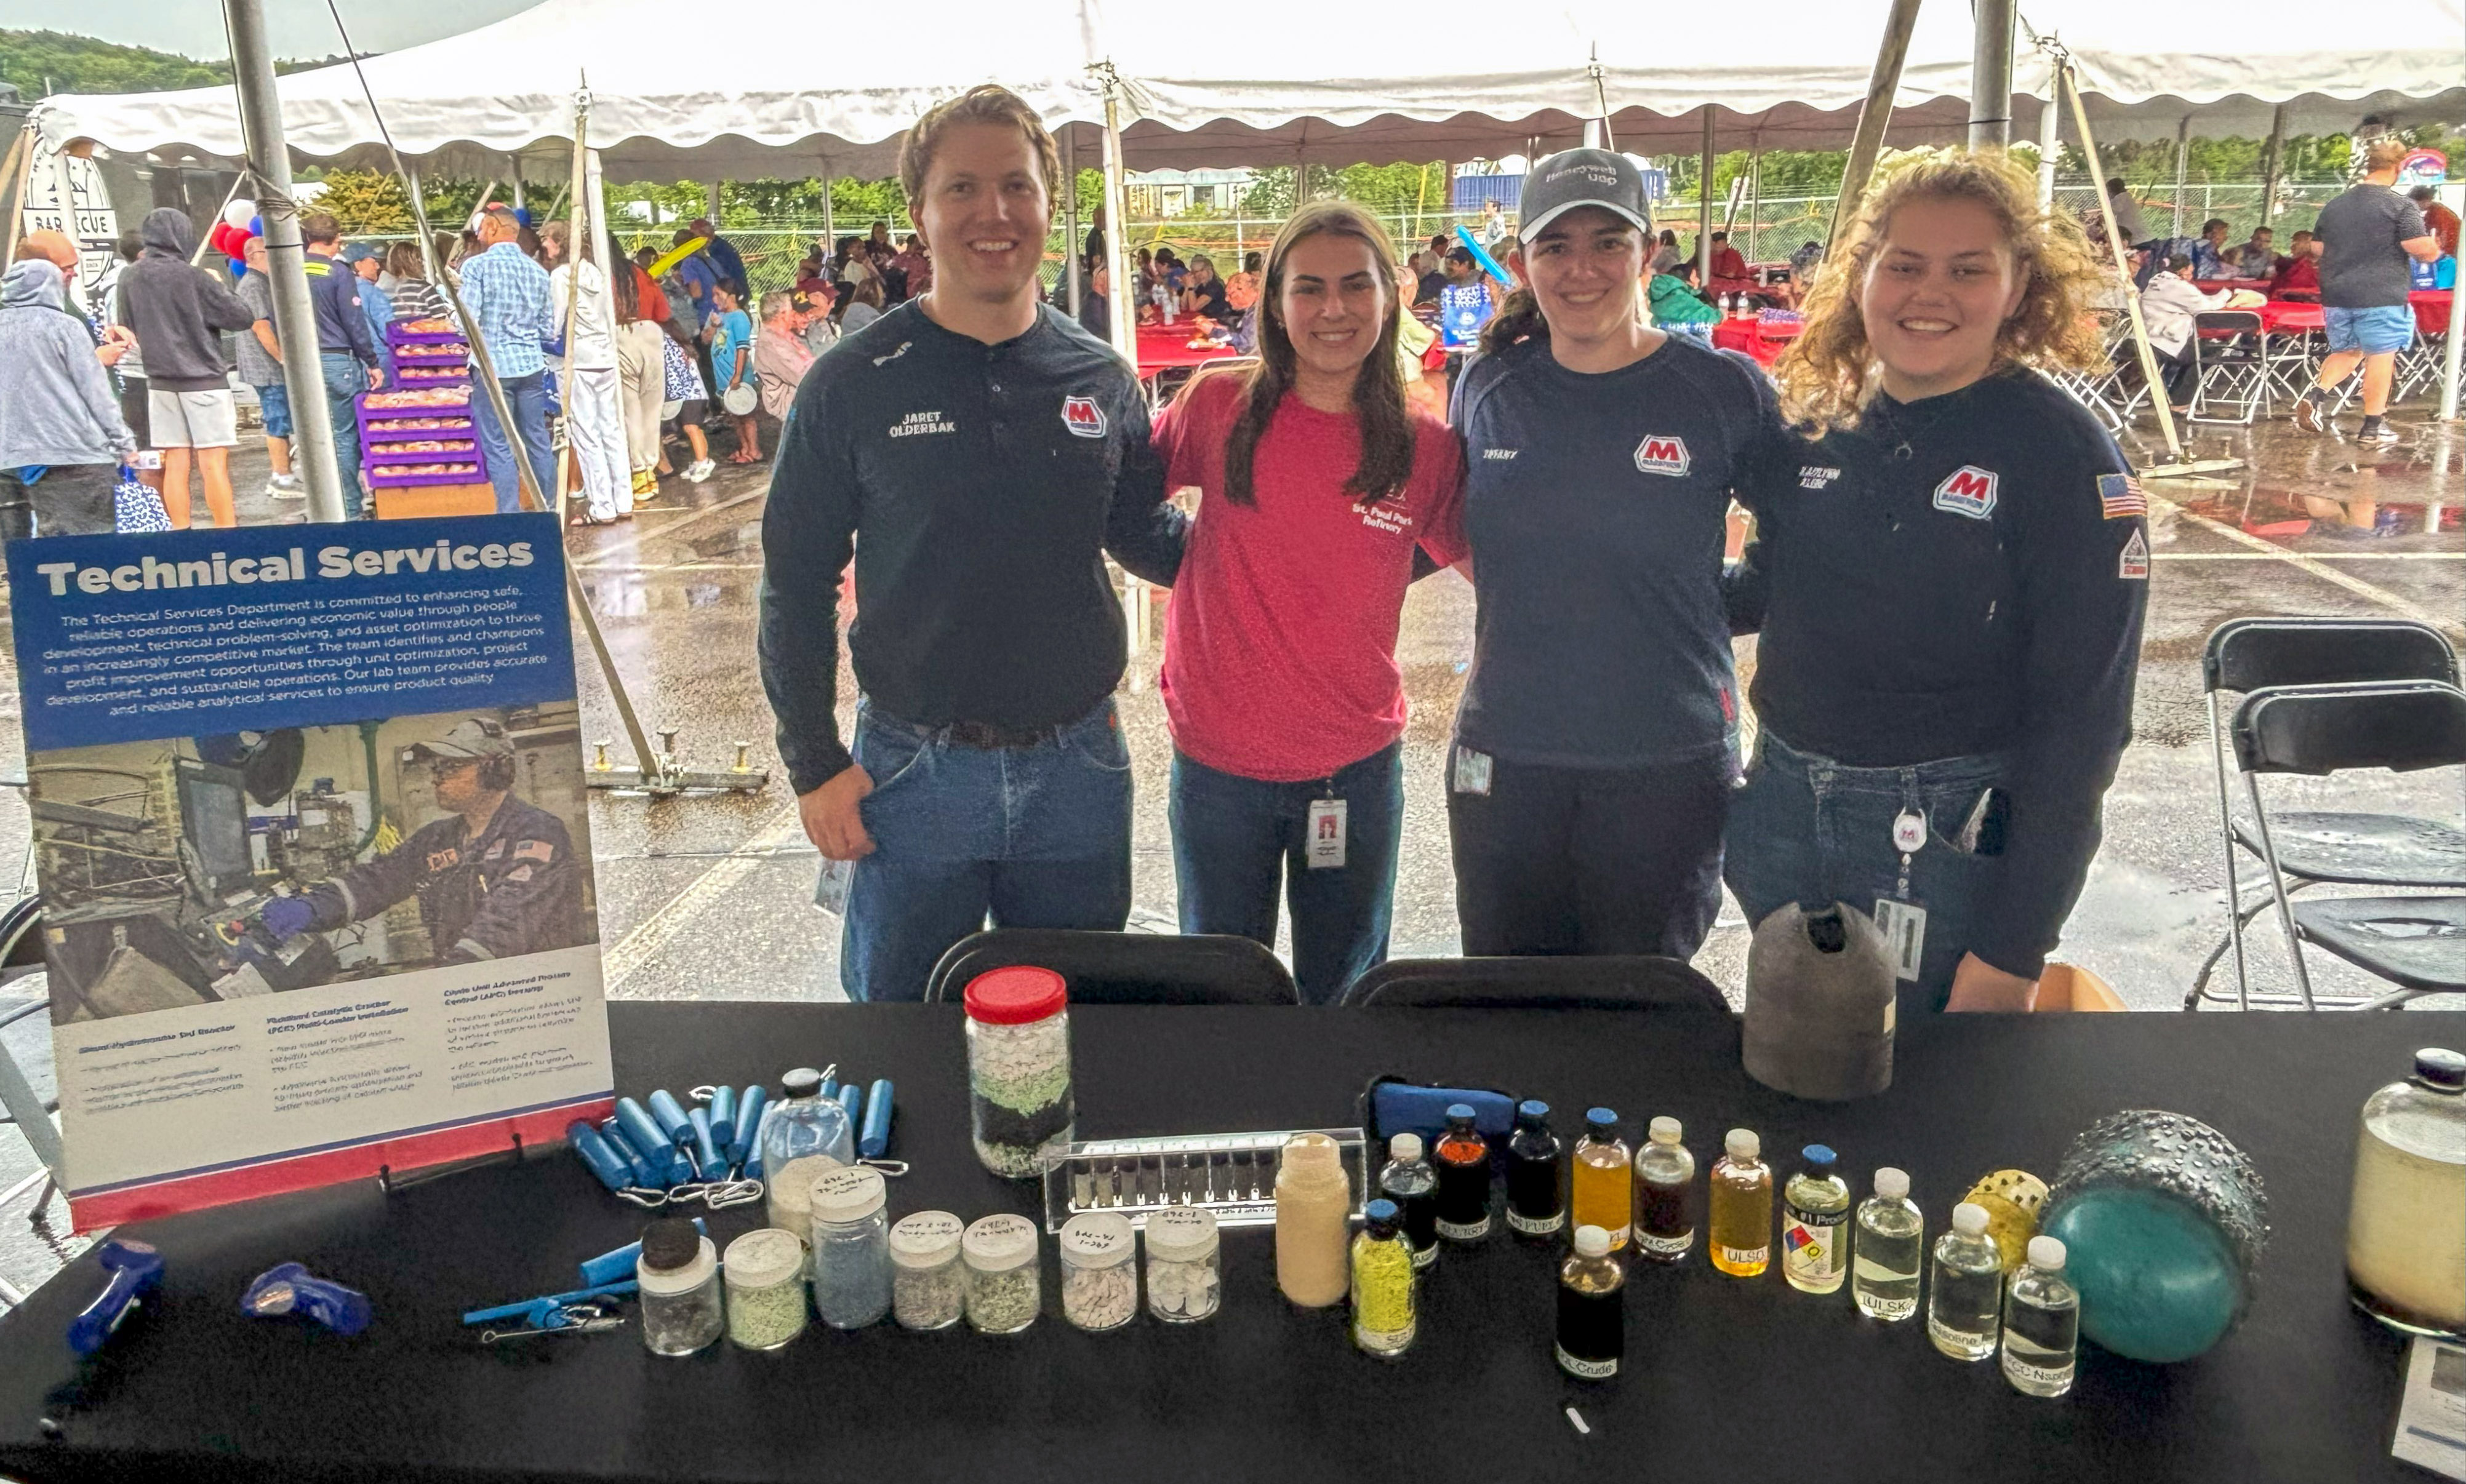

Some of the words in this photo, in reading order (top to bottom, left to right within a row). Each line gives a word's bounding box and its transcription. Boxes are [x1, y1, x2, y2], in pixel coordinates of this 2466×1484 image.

[37, 547, 306, 596] Technical
[317, 539, 534, 578] Services
[62, 615, 89, 626] The
[94, 610, 159, 624] Technical
[164, 606, 223, 620] Services
[228, 599, 310, 615] Department
[314, 599, 326, 609] is
[329, 594, 401, 608] committed
[406, 593, 420, 602] to
[423, 588, 490, 601] enhancing
[69, 628, 123, 642] reliable
[127, 622, 204, 639] operations
[207, 620, 234, 632] and
[238, 616, 306, 629] delivering
[310, 611, 377, 624] economic
[380, 607, 414, 618] value
[418, 603, 470, 615] through
[473, 600, 517, 614] people
[43, 664, 58, 674] in
[61, 664, 79, 674] an
[82, 656, 170, 671] increasingly
[174, 648, 259, 665] competitive
[318, 642, 343, 652] The
[346, 640, 380, 650] team
[384, 633, 444, 647] identifies
[447, 631, 472, 643] and
[476, 627, 545, 640] champions
[147, 637, 212, 651] technical
[337, 625, 362, 637] and
[366, 623, 400, 634] asset
[404, 616, 486, 632] optimization
[489, 615, 503, 625] to
[505, 613, 543, 624] thrive
[65, 676, 107, 690] profit
[111, 668, 206, 686] improvement
[210, 661, 304, 677] opportunities
[308, 656, 362, 668] through
[365, 653, 390, 664] unit
[483, 642, 528, 655] project
[150, 684, 177, 696] and
[181, 679, 260, 694] sustainable
[344, 668, 369, 680] Our
[374, 666, 394, 677] lab
[397, 664, 431, 675] team
[434, 660, 490, 673] provides
[493, 655, 547, 668] accurate
[110, 703, 138, 716] and
[142, 699, 194, 712] reliable
[197, 692, 264, 708] analytical
[266, 688, 324, 701] services
[327, 687, 342, 696] to
[345, 683, 390, 695] ensure
[394, 677, 446, 690] product
